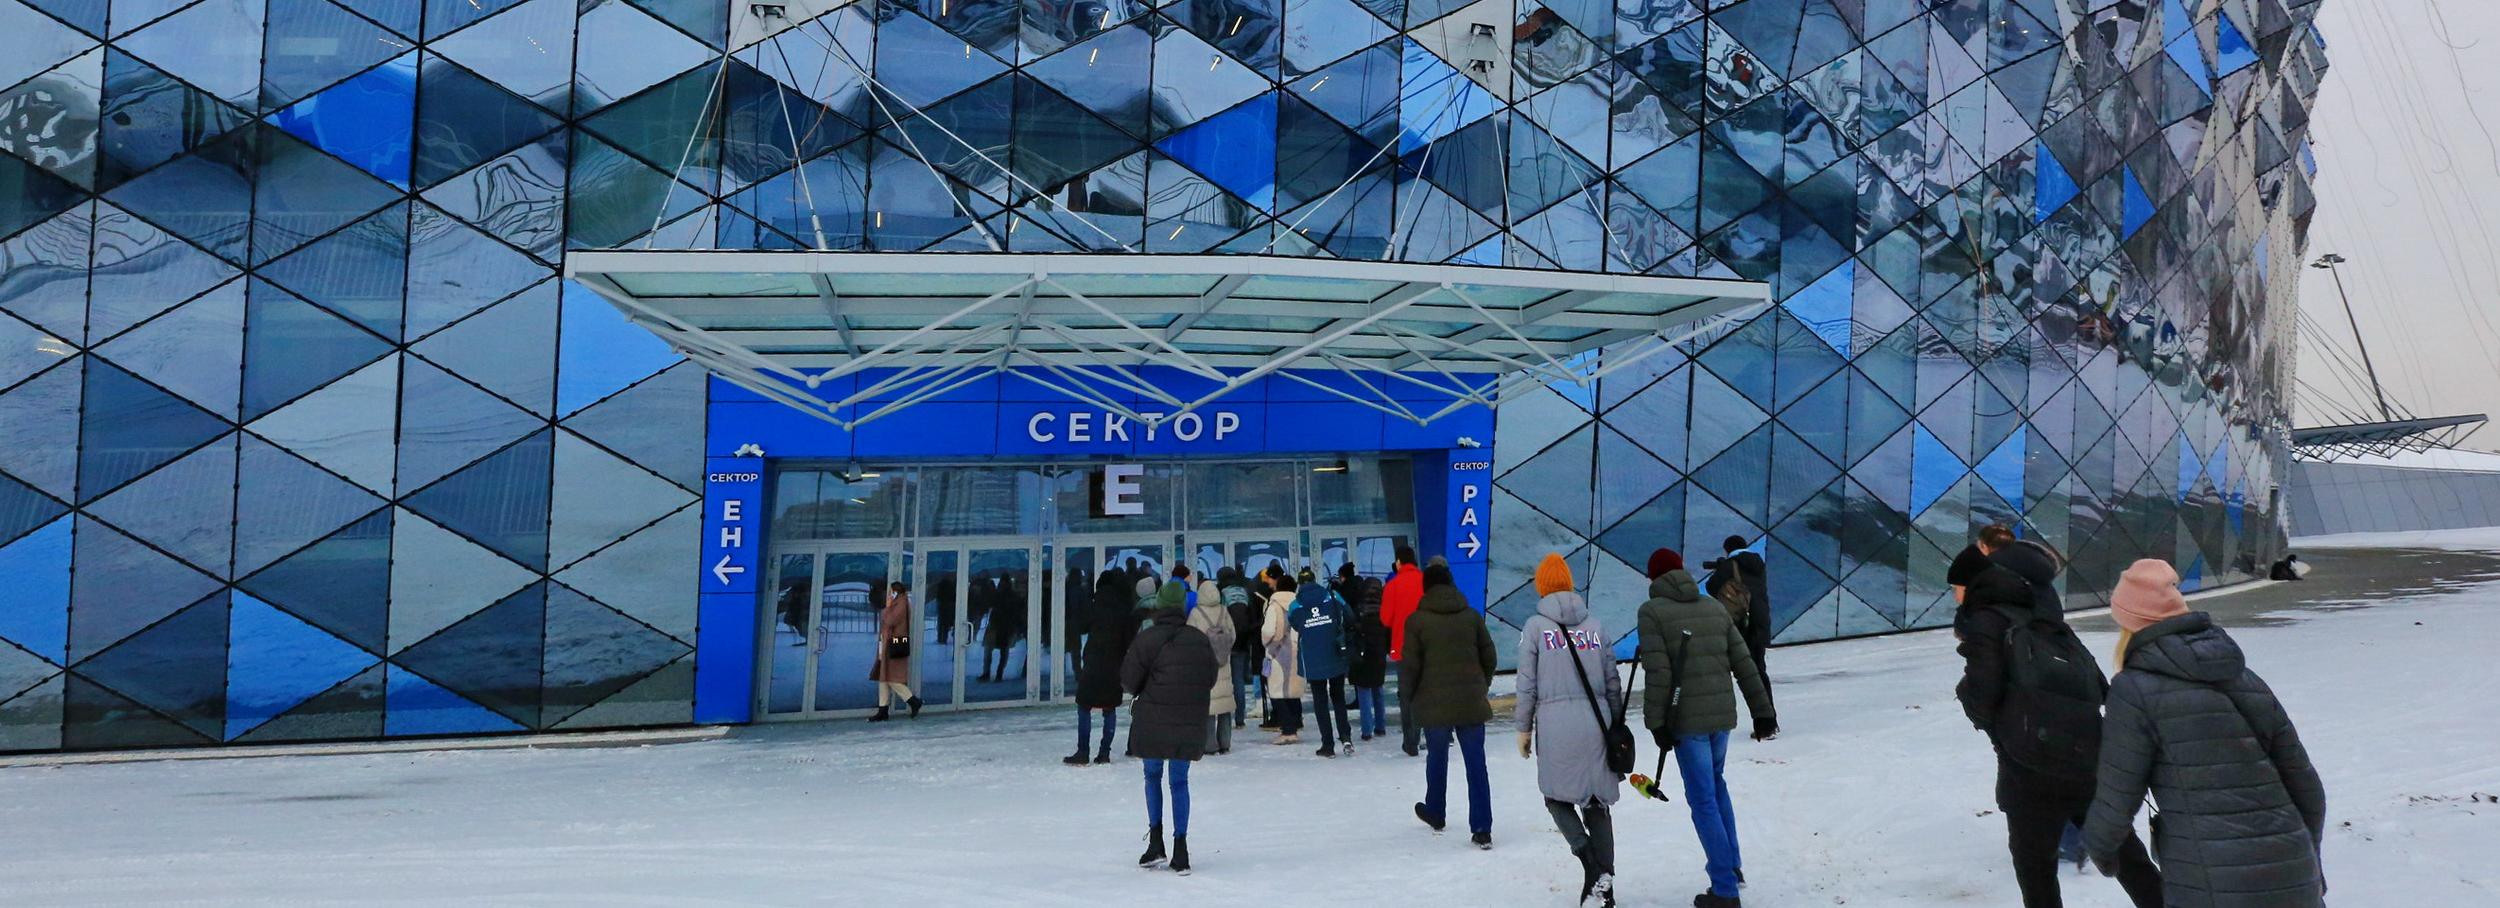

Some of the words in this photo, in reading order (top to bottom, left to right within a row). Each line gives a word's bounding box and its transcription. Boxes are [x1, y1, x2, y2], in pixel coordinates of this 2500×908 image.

[1028, 411, 1240, 443] СЕКТОР
[1453, 462, 1490, 470] СЕКТОР
[709, 473, 759, 483] СЕКТОР
[1104, 464, 1144, 515] Е
